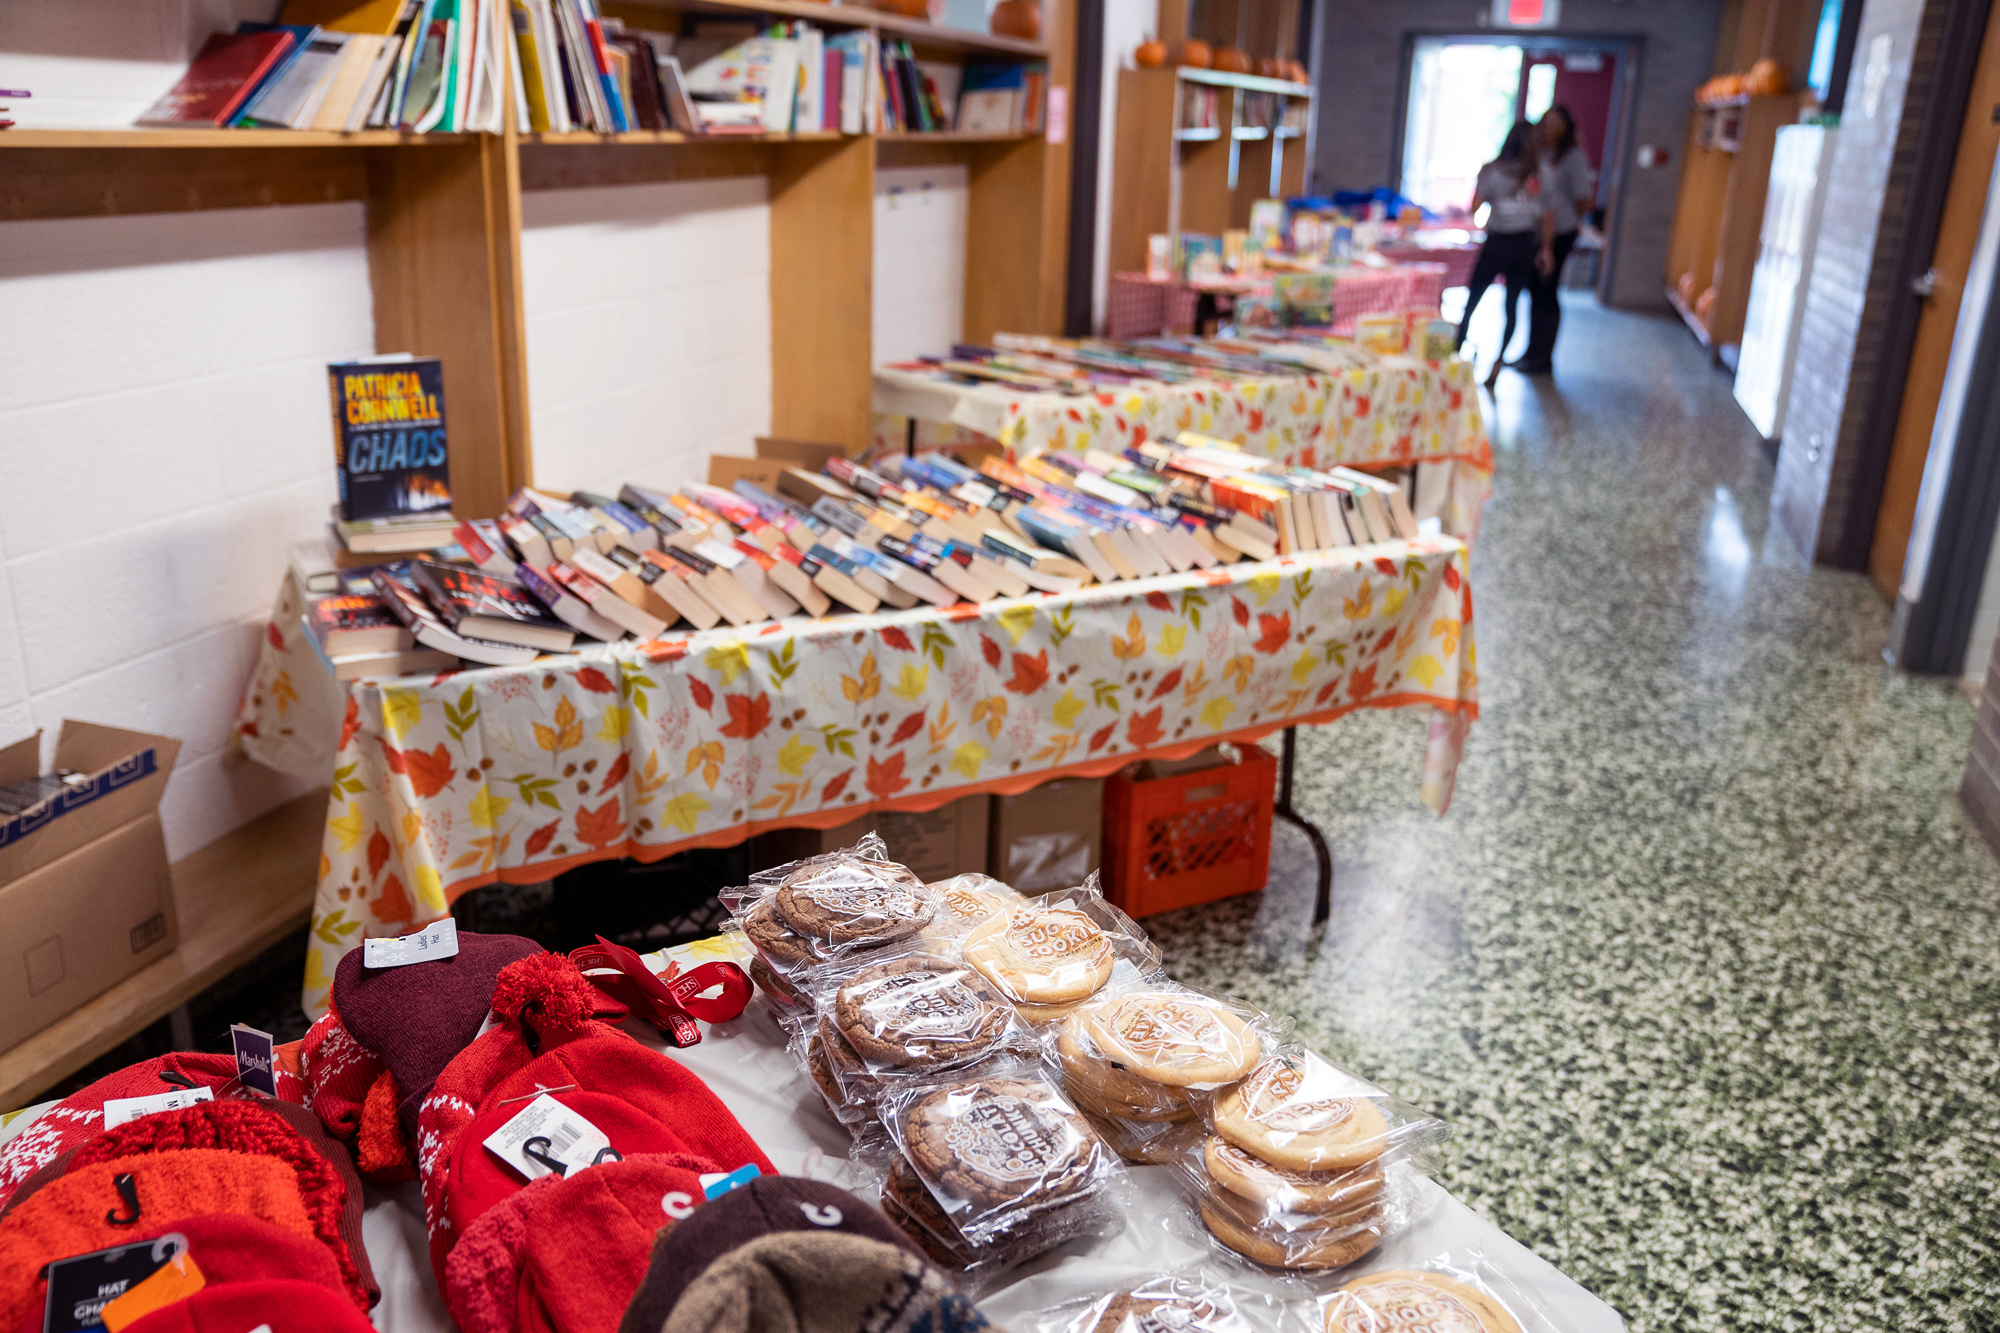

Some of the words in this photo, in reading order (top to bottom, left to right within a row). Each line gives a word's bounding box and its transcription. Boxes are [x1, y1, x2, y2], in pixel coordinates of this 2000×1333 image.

[344, 371, 424, 400] PATRICIA
[346, 393, 441, 425] CORNWELL
[347, 429, 446, 474] CHAOS
[430, 933, 440, 945] Hat
[1019, 922, 1067, 949] SUG
[239, 1050, 269, 1073] Marshalls
[1004, 1109, 1053, 1155] CHUNK
[98, 1279, 130, 1297] HAT
